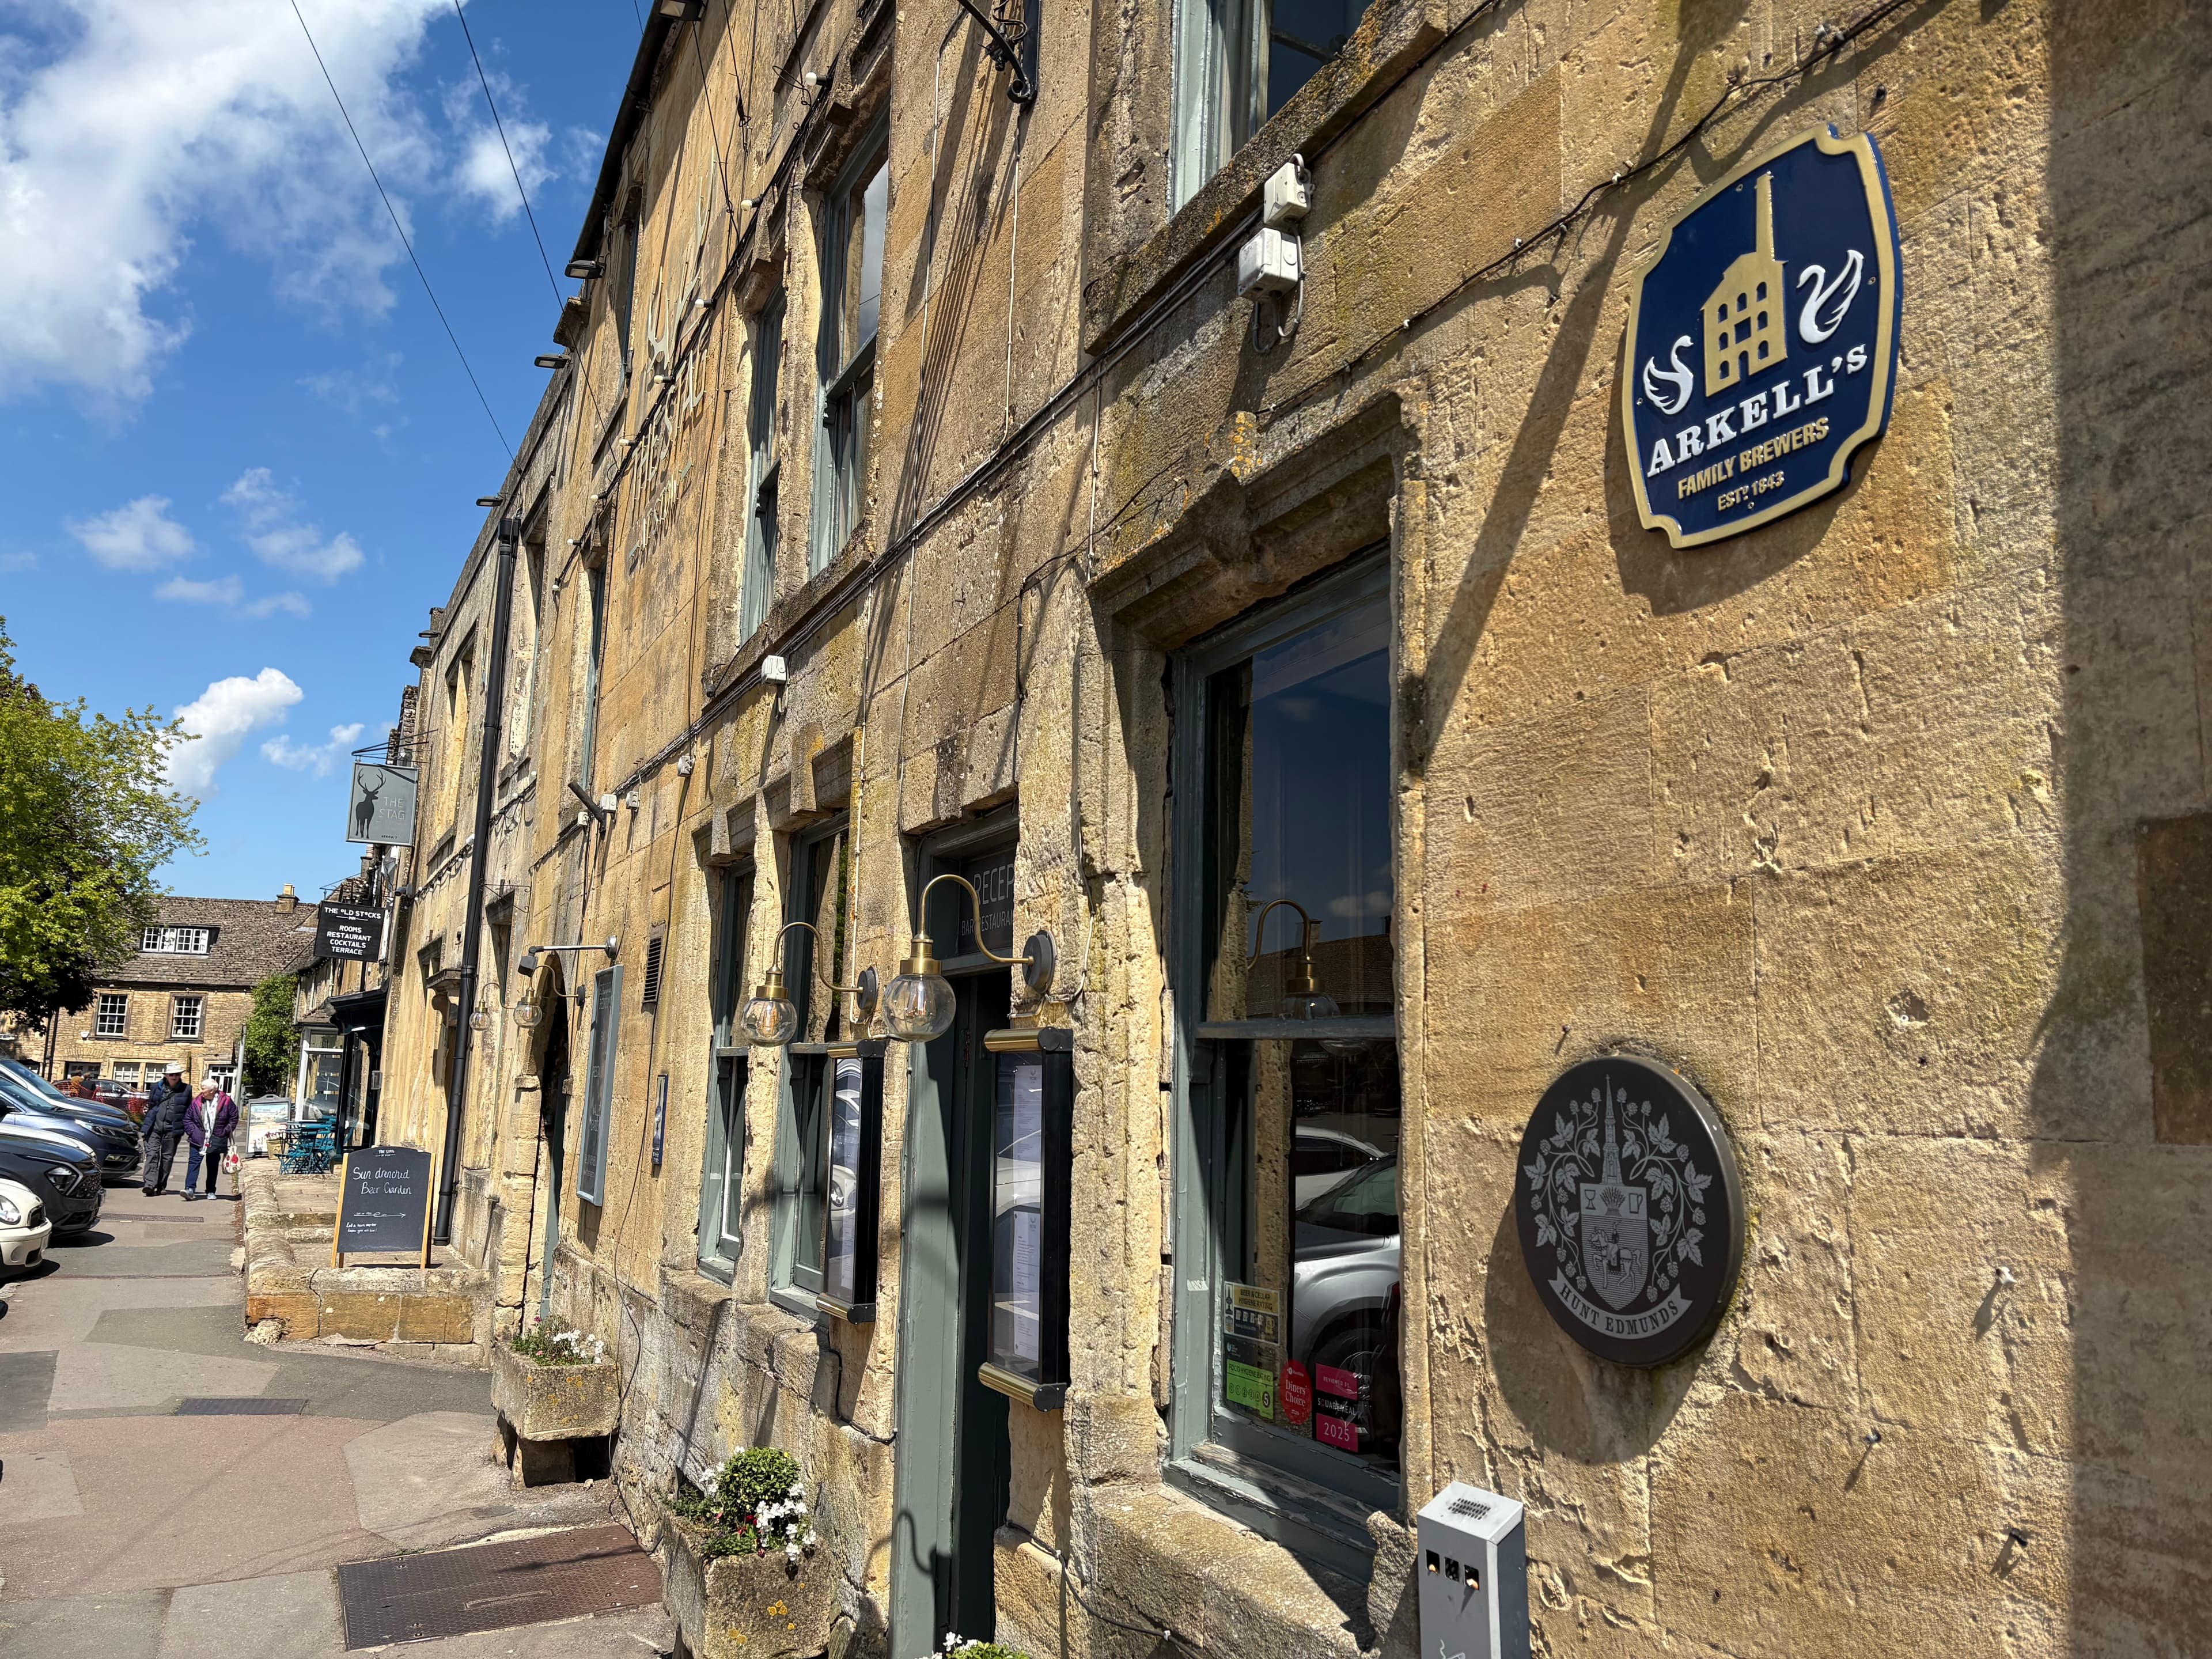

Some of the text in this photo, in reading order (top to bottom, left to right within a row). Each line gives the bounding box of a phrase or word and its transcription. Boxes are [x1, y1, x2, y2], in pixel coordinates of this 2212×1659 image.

[1647, 344, 1867, 477] ARKELL'S
[1678, 416, 1830, 499] FAMILY BREWERS
[1751, 470, 1785, 496] 1843
[384, 797, 406, 808] THE
[378, 808, 405, 820] STAG
[355, 910, 381, 919] STOCKS
[339, 925, 362, 933] ROOMS
[961, 910, 1013, 936] BAR ESTAURA
[327, 931, 372, 941] RESTAURANT
[329, 939, 366, 948] COCKTAILS
[331, 946, 363, 955] TERRACE
[353, 1166, 371, 1180] Sun
[384, 1182, 412, 1194] Garden
[1240, 1289, 1251, 1297] BEER
[1255, 1291, 1271, 1301] CELLAR
[1239, 1297, 1272, 1310] HYGIENE RATING
[1559, 1282, 1679, 1335] HUNT EDMUNDS
[1229, 1363, 1271, 1382] FOOD HYGIENE RATING
[1264, 1393, 1268, 1406] 5
[1285, 1391, 1306, 1407] Choice
[1317, 1397, 1356, 1415] SQUAREMEAL
[1324, 1422, 1350, 1442] 2025
